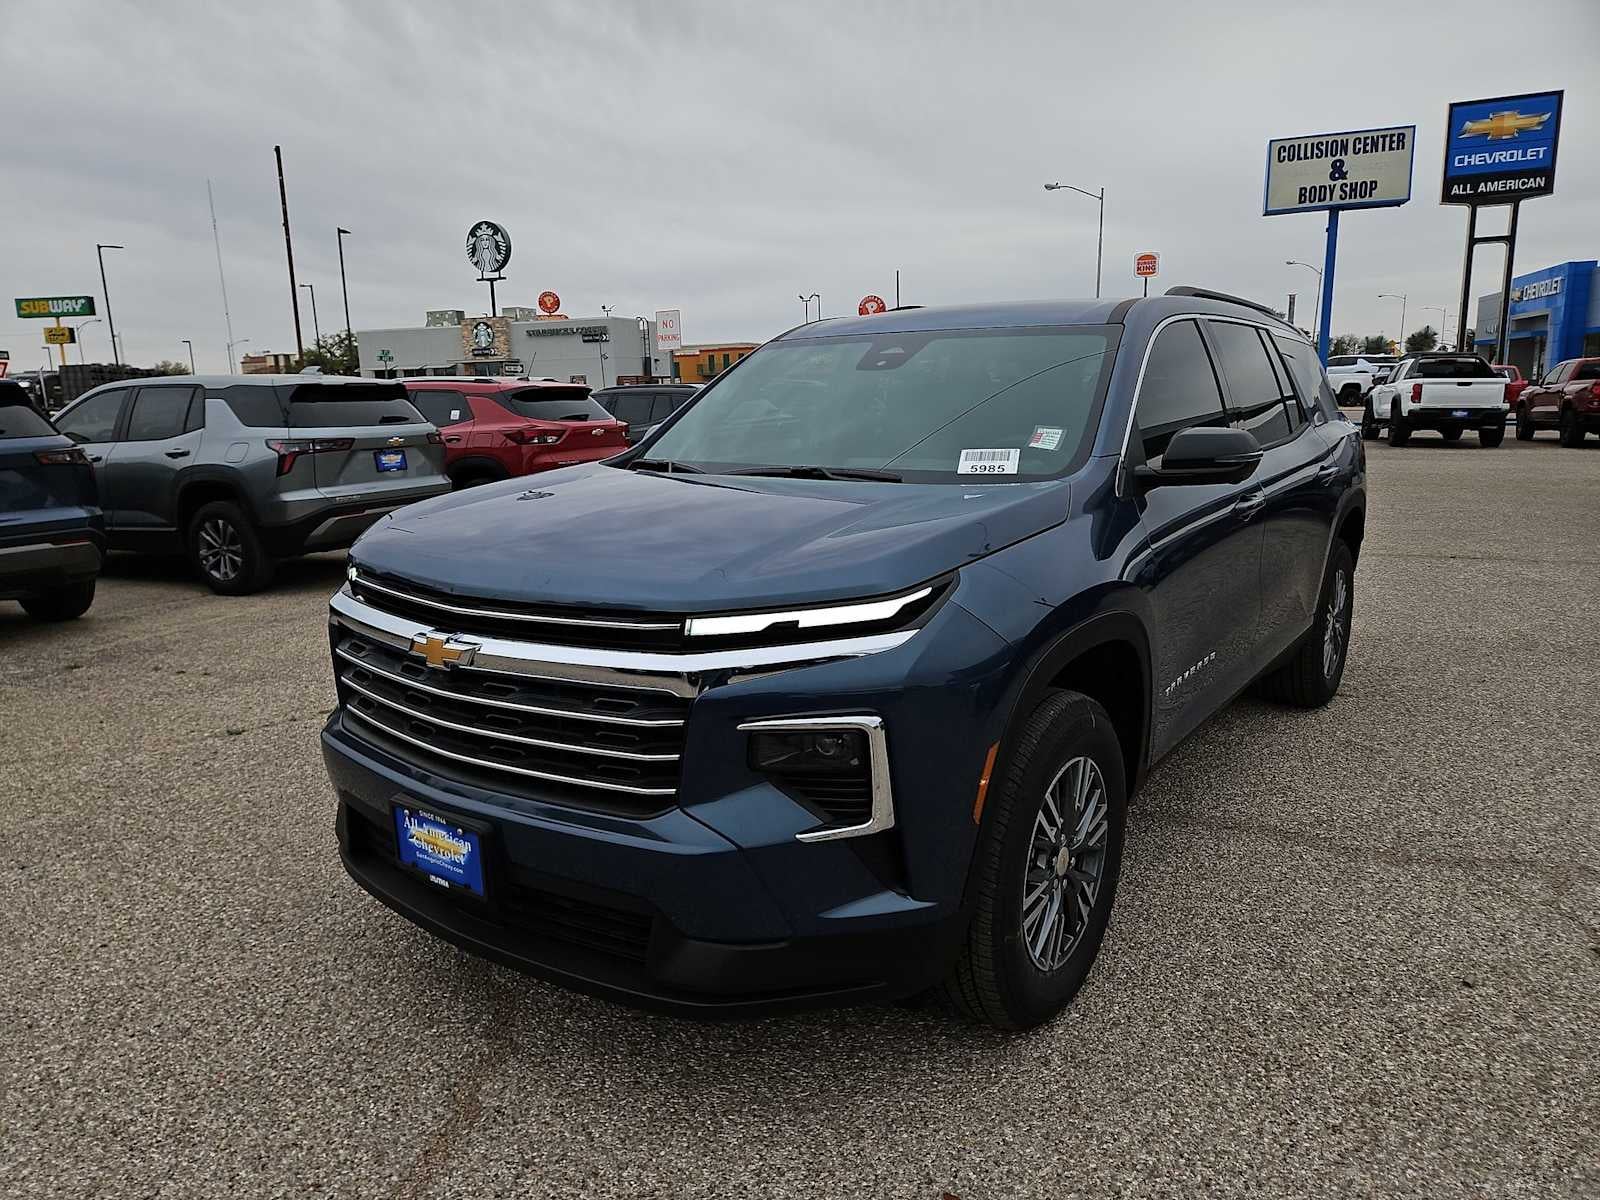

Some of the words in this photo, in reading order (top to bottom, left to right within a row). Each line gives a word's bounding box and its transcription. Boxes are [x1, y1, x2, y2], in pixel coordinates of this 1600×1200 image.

[1277, 138, 1349, 163] COLLISION
[1352, 132, 1406, 155] CENTER
[1454, 146, 1548, 167] CHEVROLET
[1329, 158, 1348, 181] &
[1298, 183, 1336, 204] BODY
[1339, 180, 1378, 201] SHOP
[1451, 184, 1475, 195] ALL
[1478, 177, 1546, 193] AMERICAN
[1136, 264, 1156, 272] KING
[1523, 276, 1562, 301] CHEVROLET
[20, 299, 82, 314] SUBWAY
[662, 319, 674, 329] NO
[657, 333, 680, 342] PARKING
[970, 464, 1006, 473] 5985
[403, 816, 418, 831] All
[413, 836, 465, 865] Chevrolet
